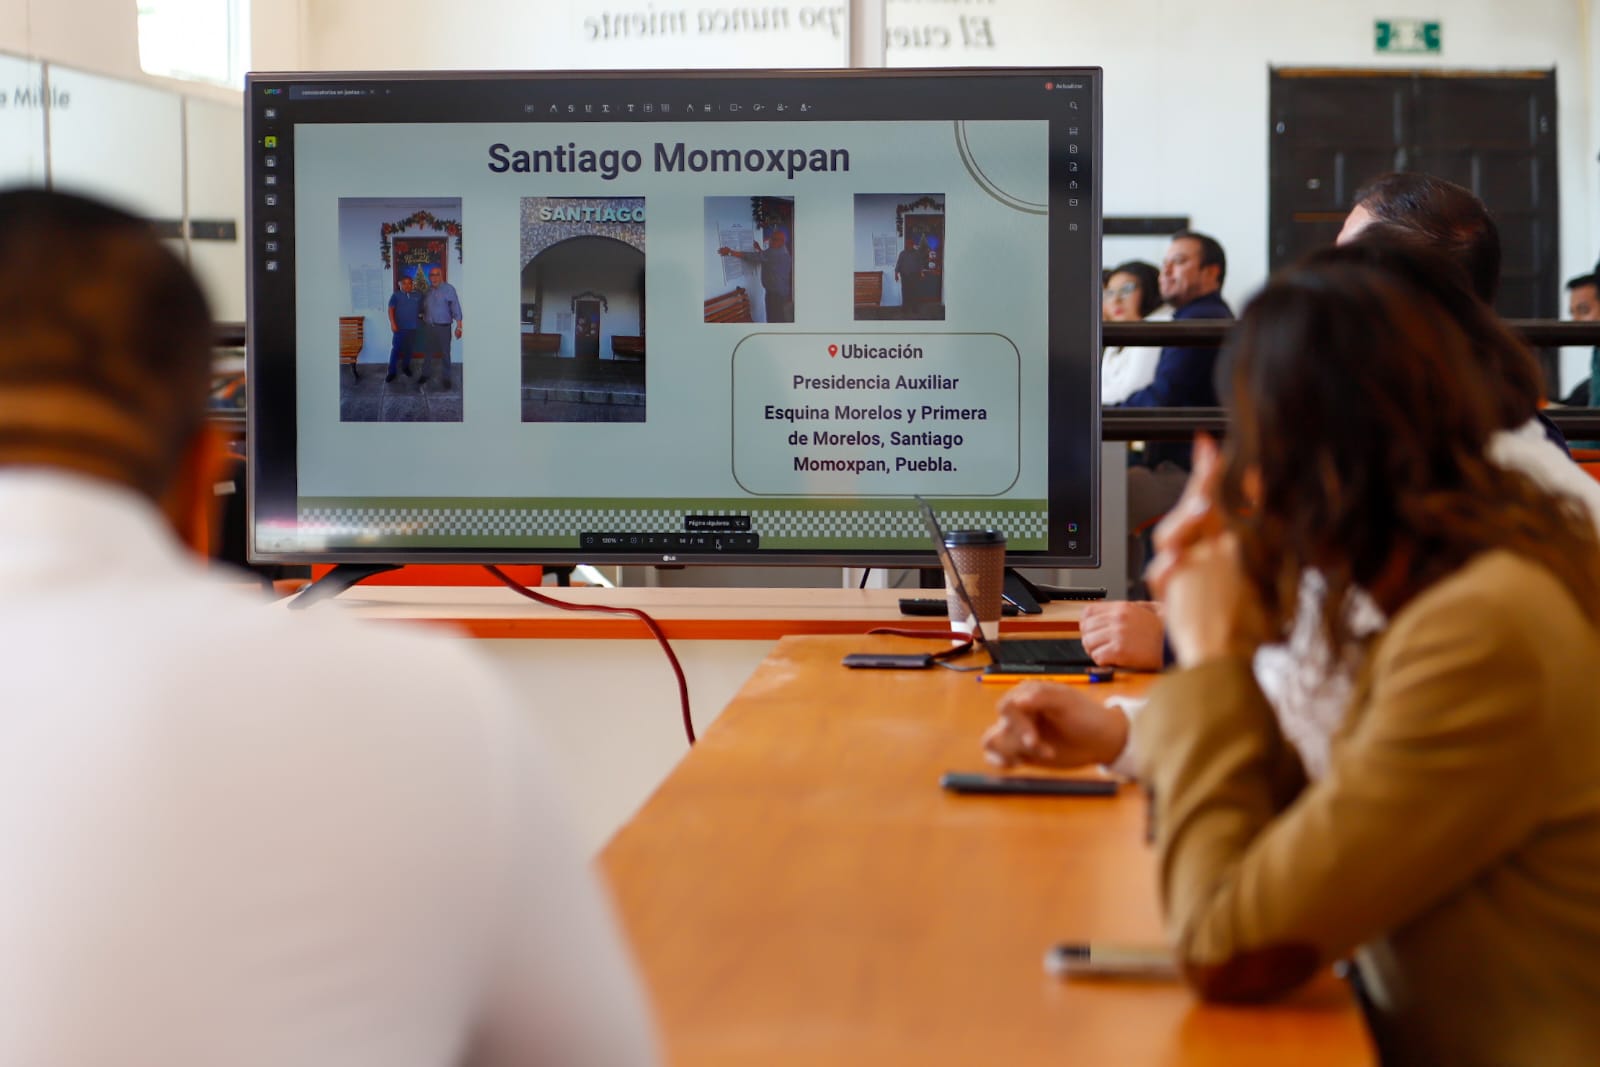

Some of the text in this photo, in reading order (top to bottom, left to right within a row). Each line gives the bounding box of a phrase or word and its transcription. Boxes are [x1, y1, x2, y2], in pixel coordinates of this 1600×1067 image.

[14, 86, 71, 108] Mile
[488, 142, 850, 180] Santiago Momoxpan
[540, 206, 646, 222] SANTIAGO
[841, 344, 923, 359] Ubicación
[793, 375, 959, 390] Presidencia Auxiliar
[764, 405, 987, 424] Esquina Morelos y Primera
[788, 431, 963, 449] de Morelos, Santiago
[793, 457, 957, 474] Momoxpan, Puebla.
